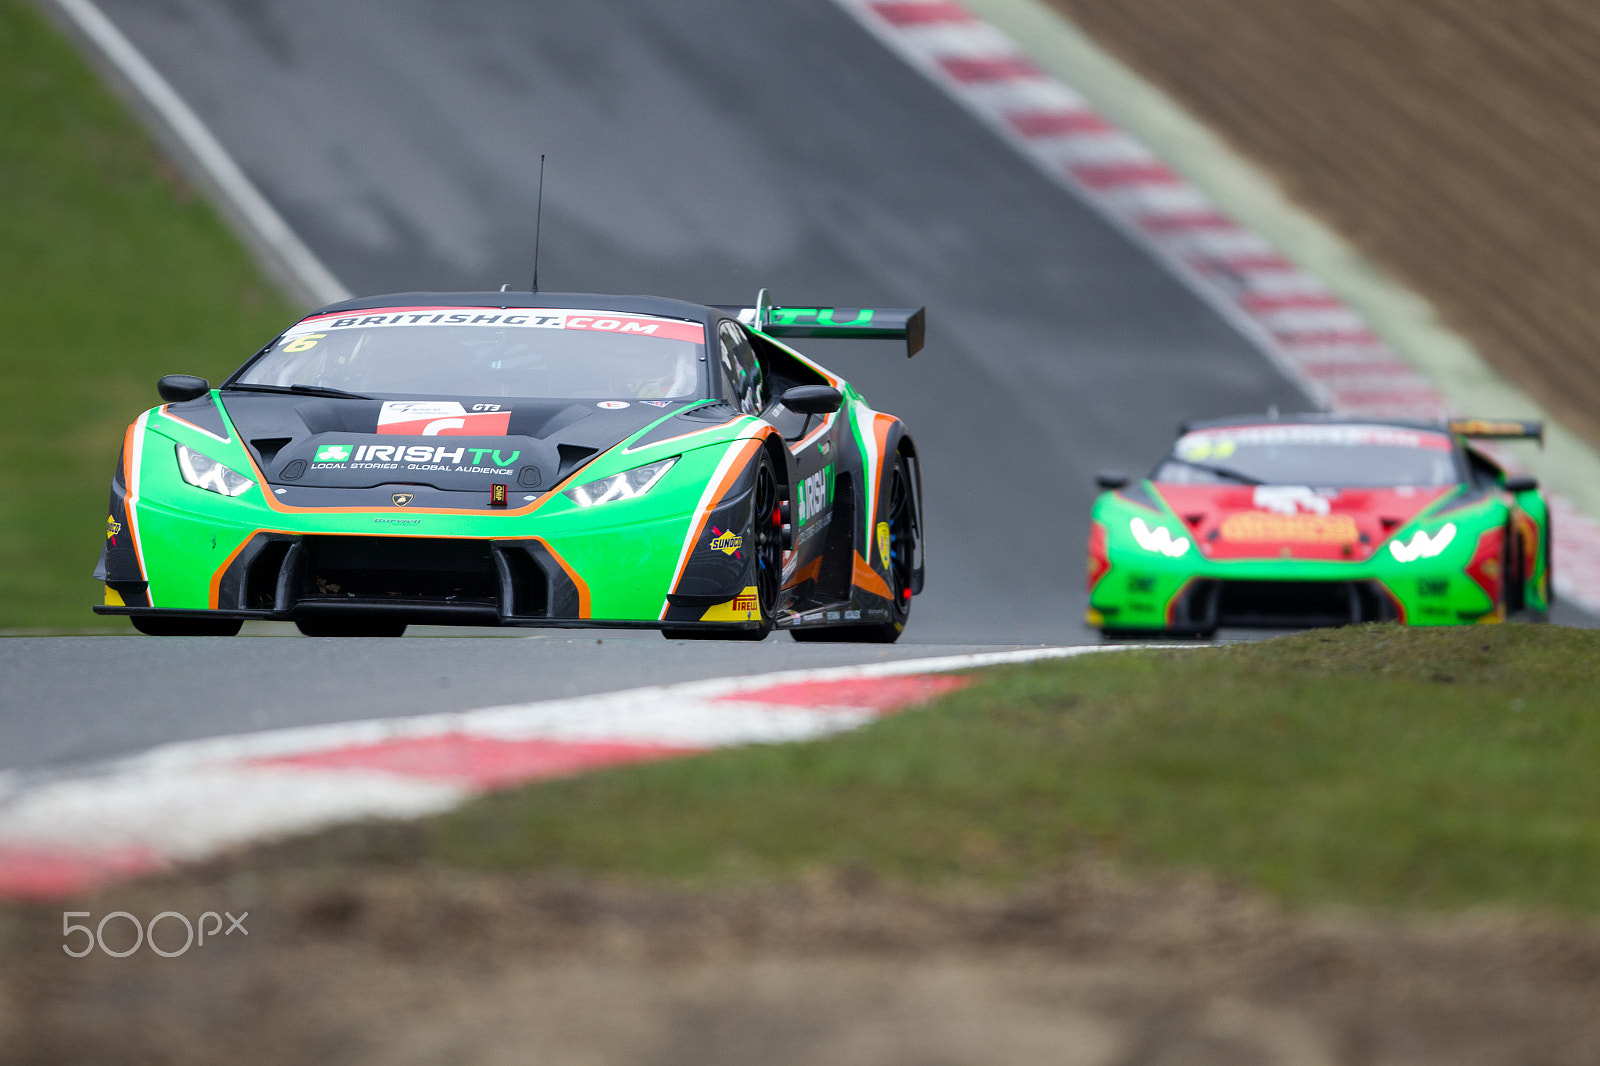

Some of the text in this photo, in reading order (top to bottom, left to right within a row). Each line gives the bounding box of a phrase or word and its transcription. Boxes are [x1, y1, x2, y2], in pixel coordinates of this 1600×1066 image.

[330, 313, 660, 334] BRITISHGT.COM
[283, 333, 327, 353] 6
[472, 403, 501, 411] GT3
[407, 463, 452, 472] GLOBAL
[455, 465, 514, 476] AUDIENCE
[712, 537, 742, 549] SUNOCO
